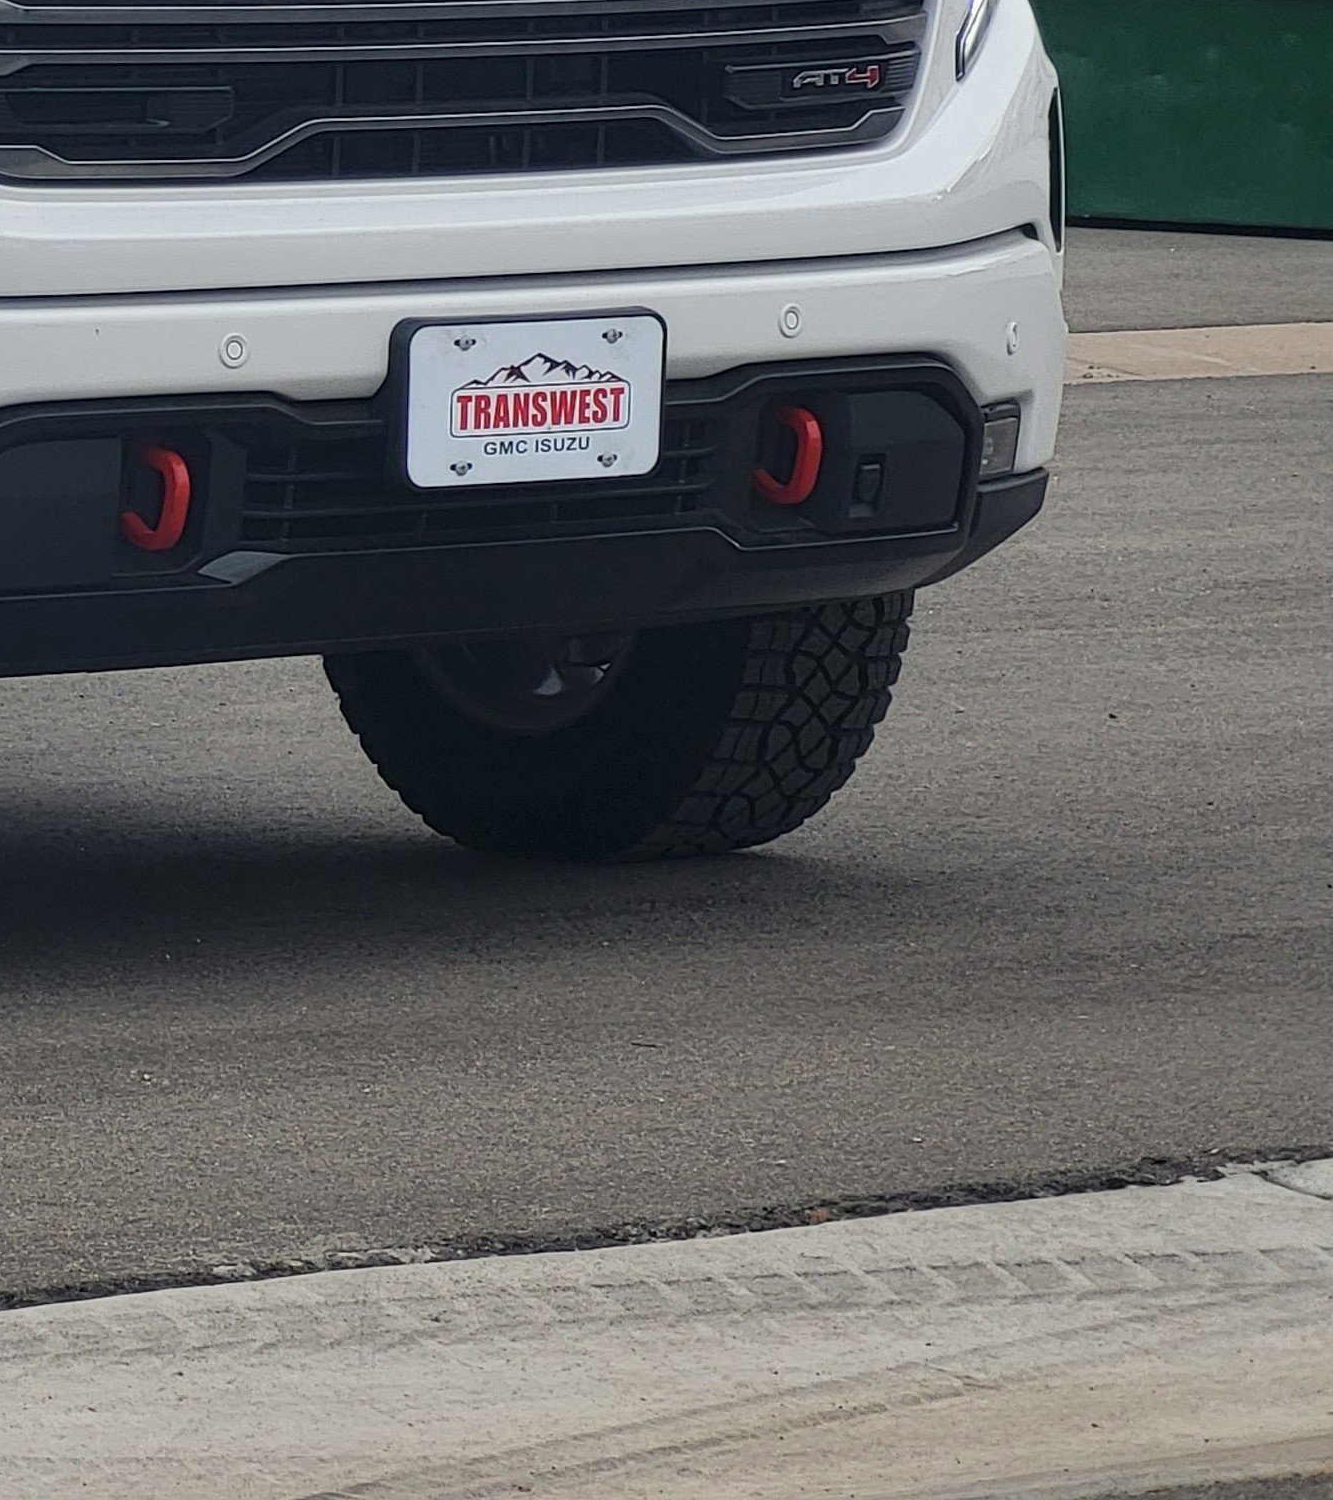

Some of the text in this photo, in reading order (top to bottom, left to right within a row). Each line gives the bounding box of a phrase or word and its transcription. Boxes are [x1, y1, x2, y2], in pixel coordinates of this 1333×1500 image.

[792, 65, 880, 89] AT4
[456, 387, 625, 431] TRANSWEST
[483, 436, 591, 456] GMC ISUZU
